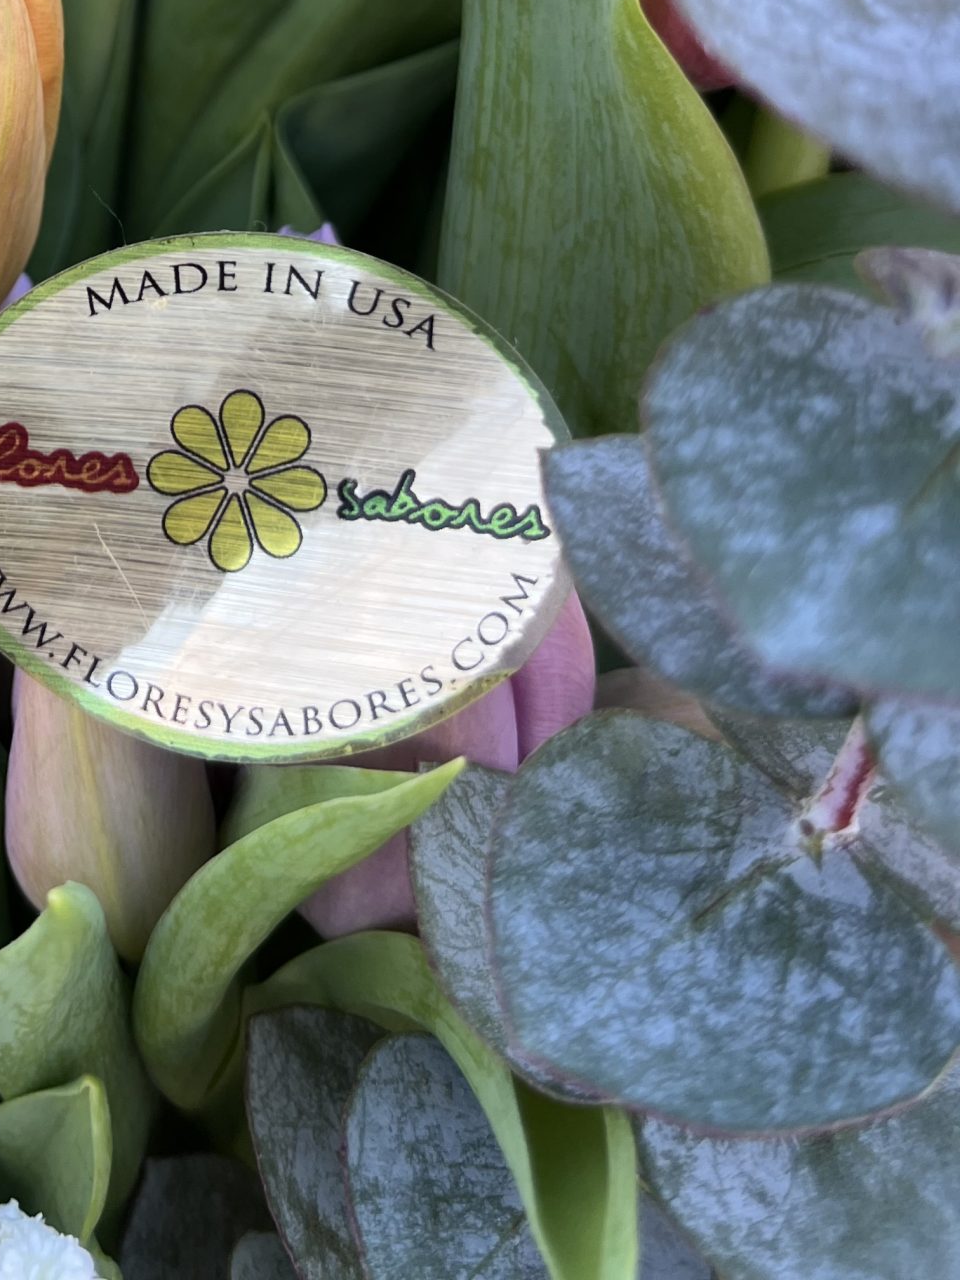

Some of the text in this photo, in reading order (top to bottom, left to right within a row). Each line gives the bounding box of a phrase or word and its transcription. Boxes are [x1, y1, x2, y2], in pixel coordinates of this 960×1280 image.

[86, 260, 439, 351] MADE IN USA
[337, 469, 551, 541] sabores
